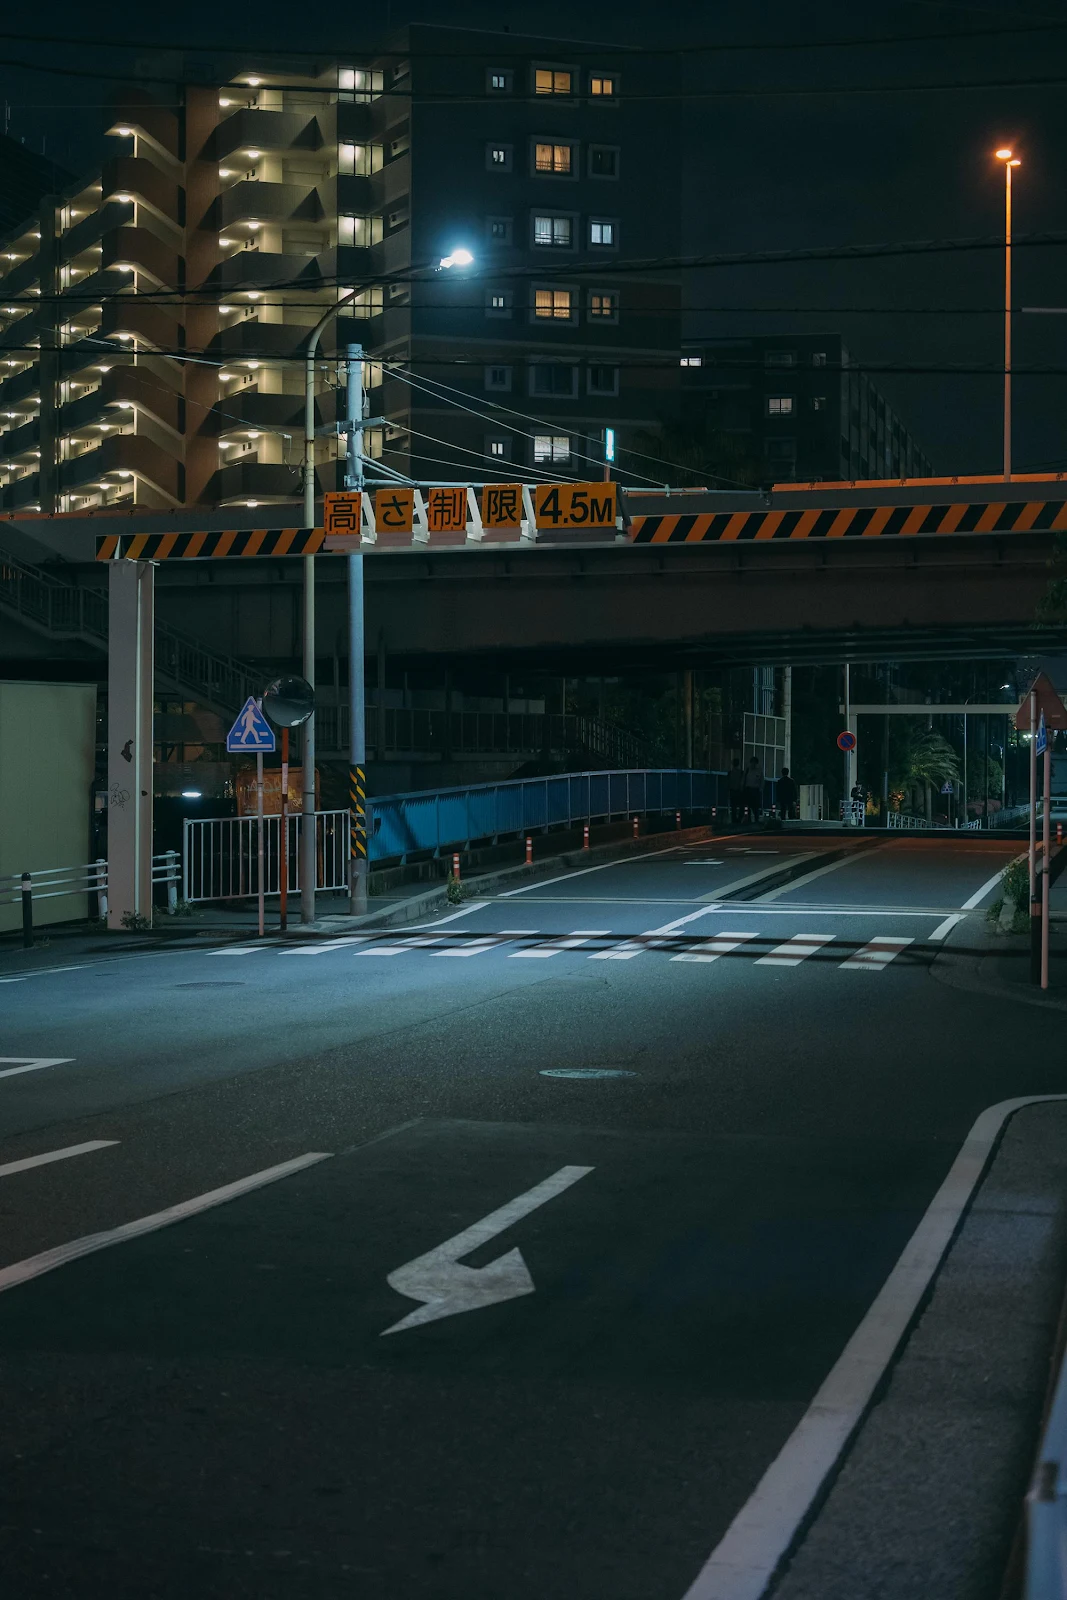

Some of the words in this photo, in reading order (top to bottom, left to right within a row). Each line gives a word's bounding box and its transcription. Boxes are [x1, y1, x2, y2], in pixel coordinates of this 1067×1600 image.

[329, 489, 517, 532] 高さ制限
[539, 488, 612, 524] 4.5M
